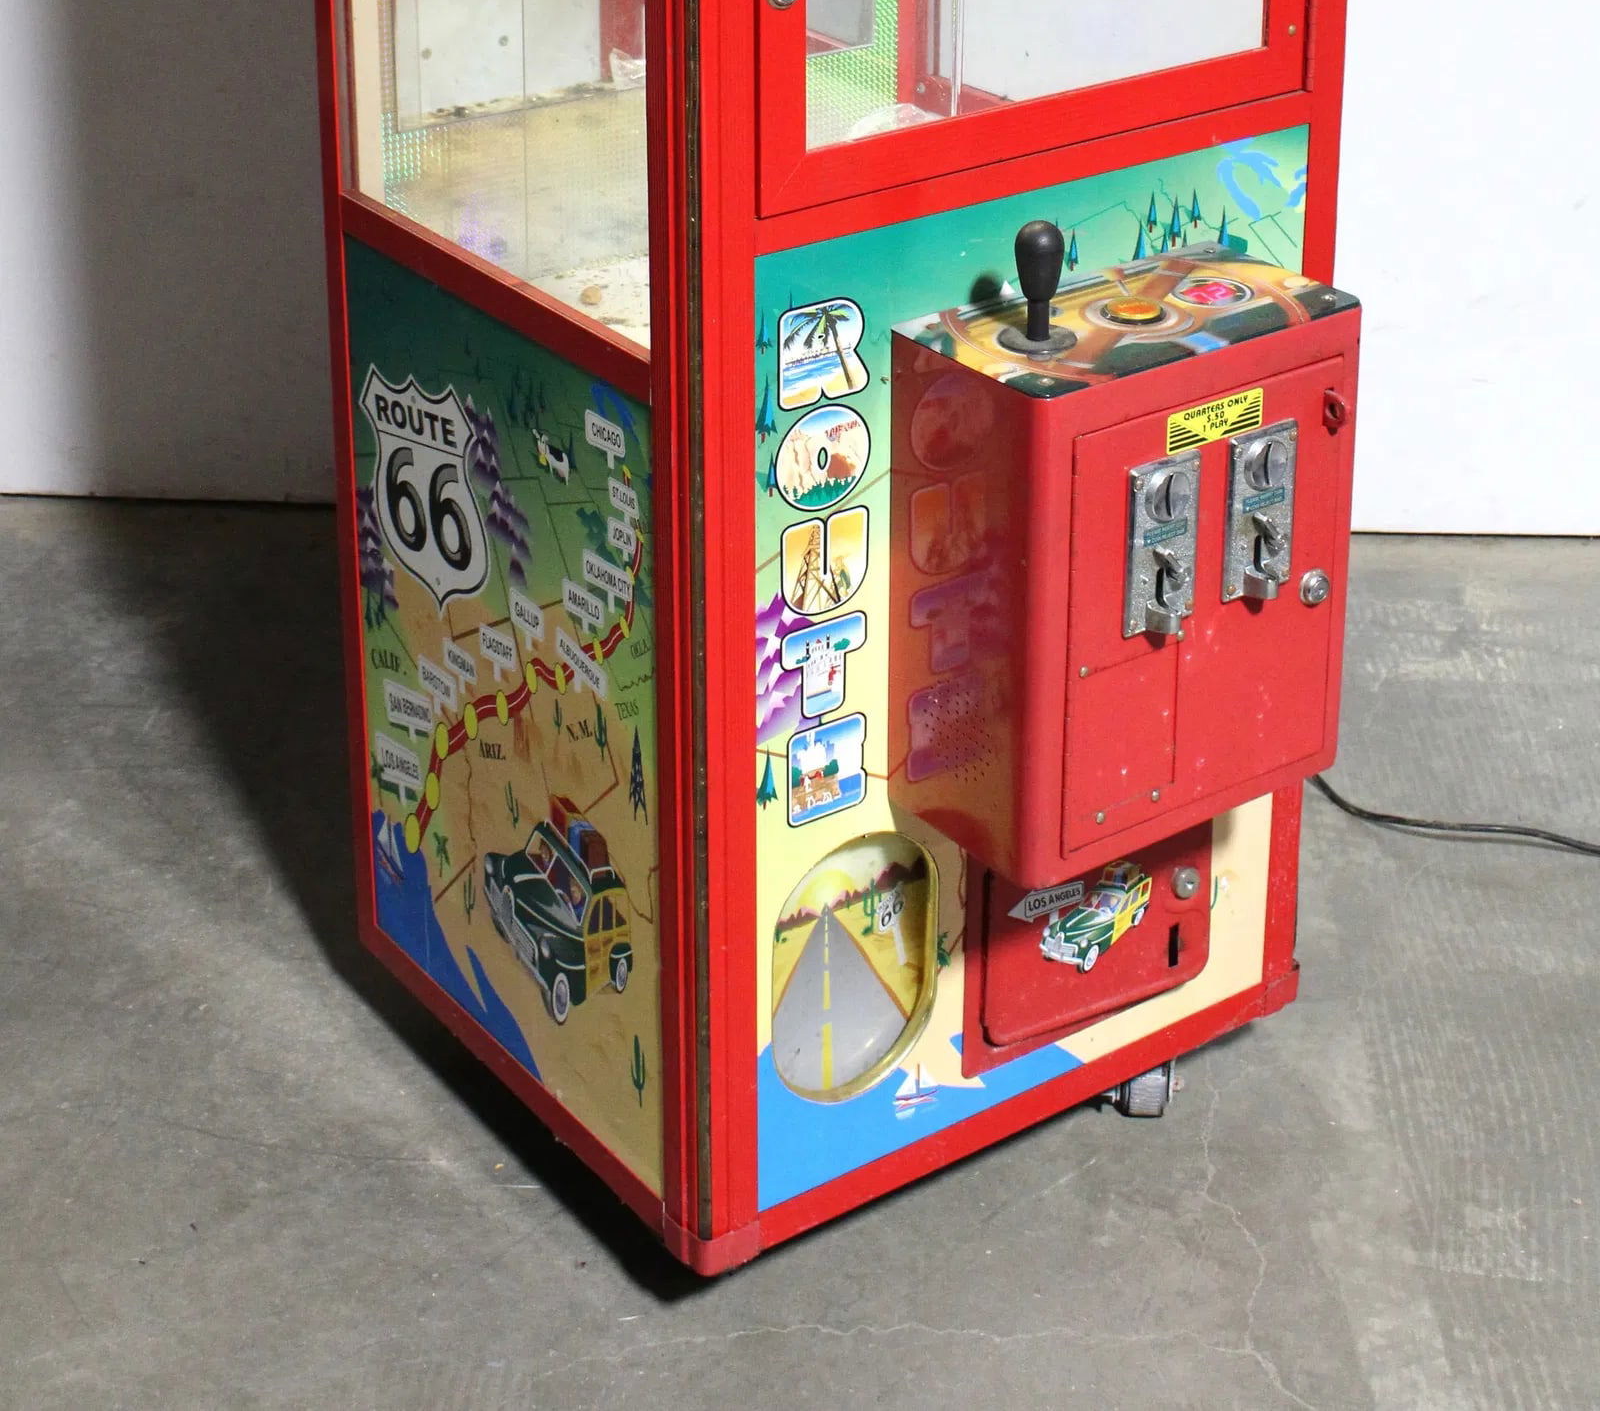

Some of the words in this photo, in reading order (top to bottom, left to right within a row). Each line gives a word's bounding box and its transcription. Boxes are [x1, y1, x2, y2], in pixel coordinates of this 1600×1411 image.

[374, 393, 458, 449] ROUTE
[1184, 401, 1225, 421] QUARTERS
[1227, 394, 1249, 408] ONLY
[1207, 410, 1225, 422] $.50
[591, 421, 623, 448] CHICAGO
[1203, 425, 1206, 433] 1
[1210, 419, 1229, 431] PLAY
[386, 447, 472, 572] 66
[612, 525, 633, 547] JOPLIN
[586, 560, 618, 590] OKLAHOMA
[618, 578, 632, 601] CITY
[514, 602, 541, 629] GALLUP
[568, 590, 601, 621] AMARILLO
[481, 631, 514, 662] FLAGSTAFF
[479, 739, 507, 762] ARIZ.
[881, 891, 904, 927] 66
[1028, 897, 1047, 912] LOS
[1049, 888, 1081, 906] ANGELES
